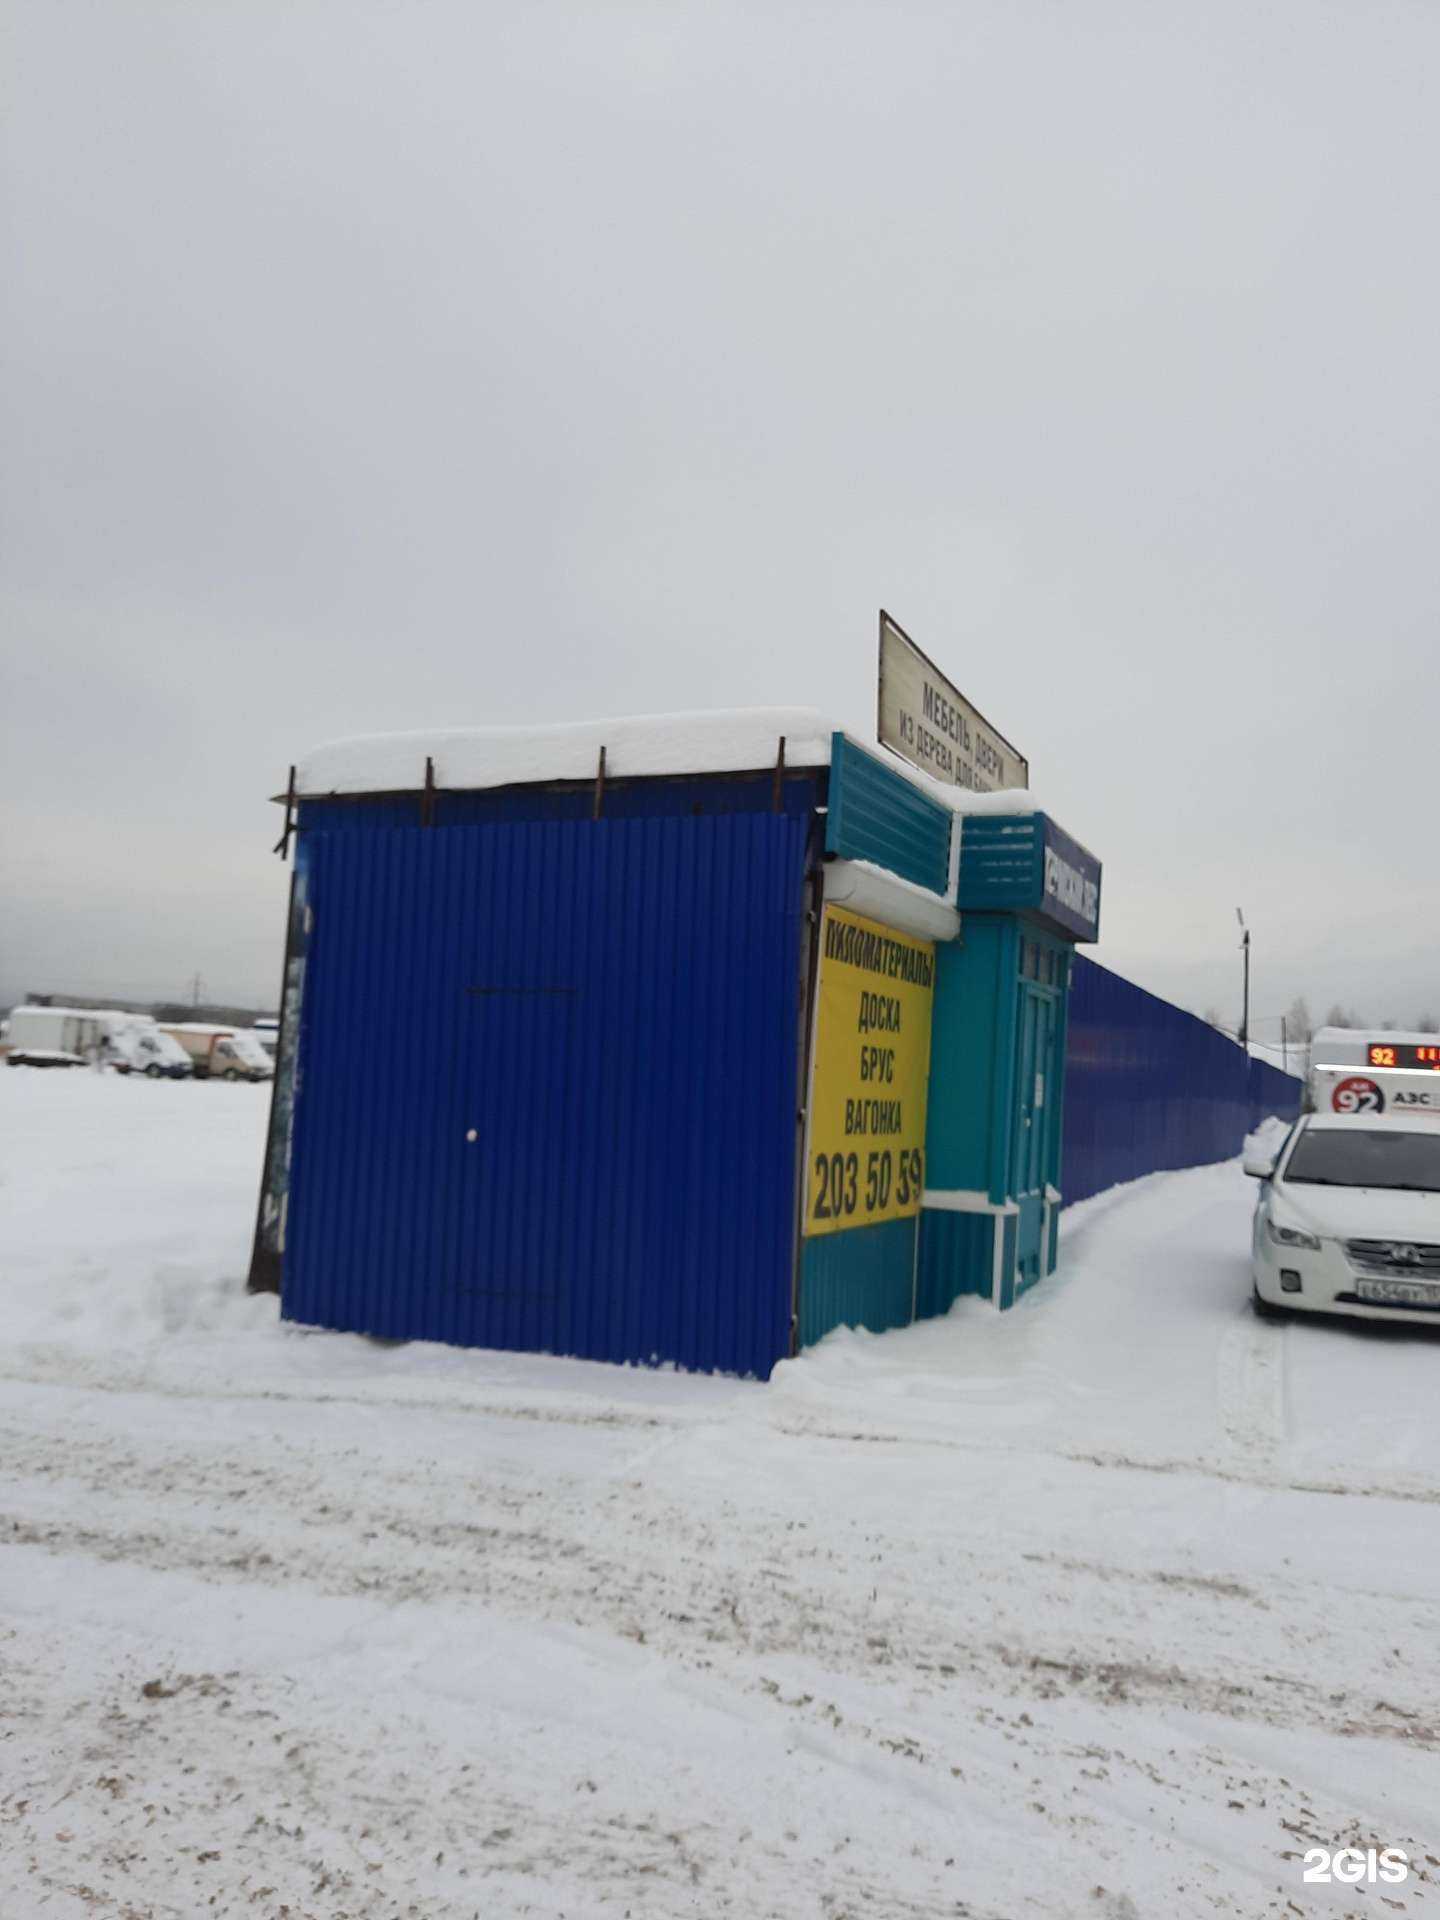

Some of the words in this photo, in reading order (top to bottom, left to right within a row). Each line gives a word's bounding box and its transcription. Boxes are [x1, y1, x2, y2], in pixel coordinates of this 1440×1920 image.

[899, 709, 914, 745] ИЗ
[916, 724, 953, 776] ДЕРЕВА
[975, 732, 1005, 787] ДВЕРИ
[825, 918, 934, 988] ПИЛОМАТЕРИАЛЫ
[857, 990, 901, 1035] ДОСКА
[860, 1045, 896, 1083] БРУС
[1370, 1047, 1395, 1066] 92
[844, 1099, 902, 1135] ВАГОНКА
[1338, 1089, 1380, 1114] 92
[1393, 1091, 1431, 1105] АЗС
[813, 1152, 859, 1218] 203
[865, 1151, 892, 1212] 50
